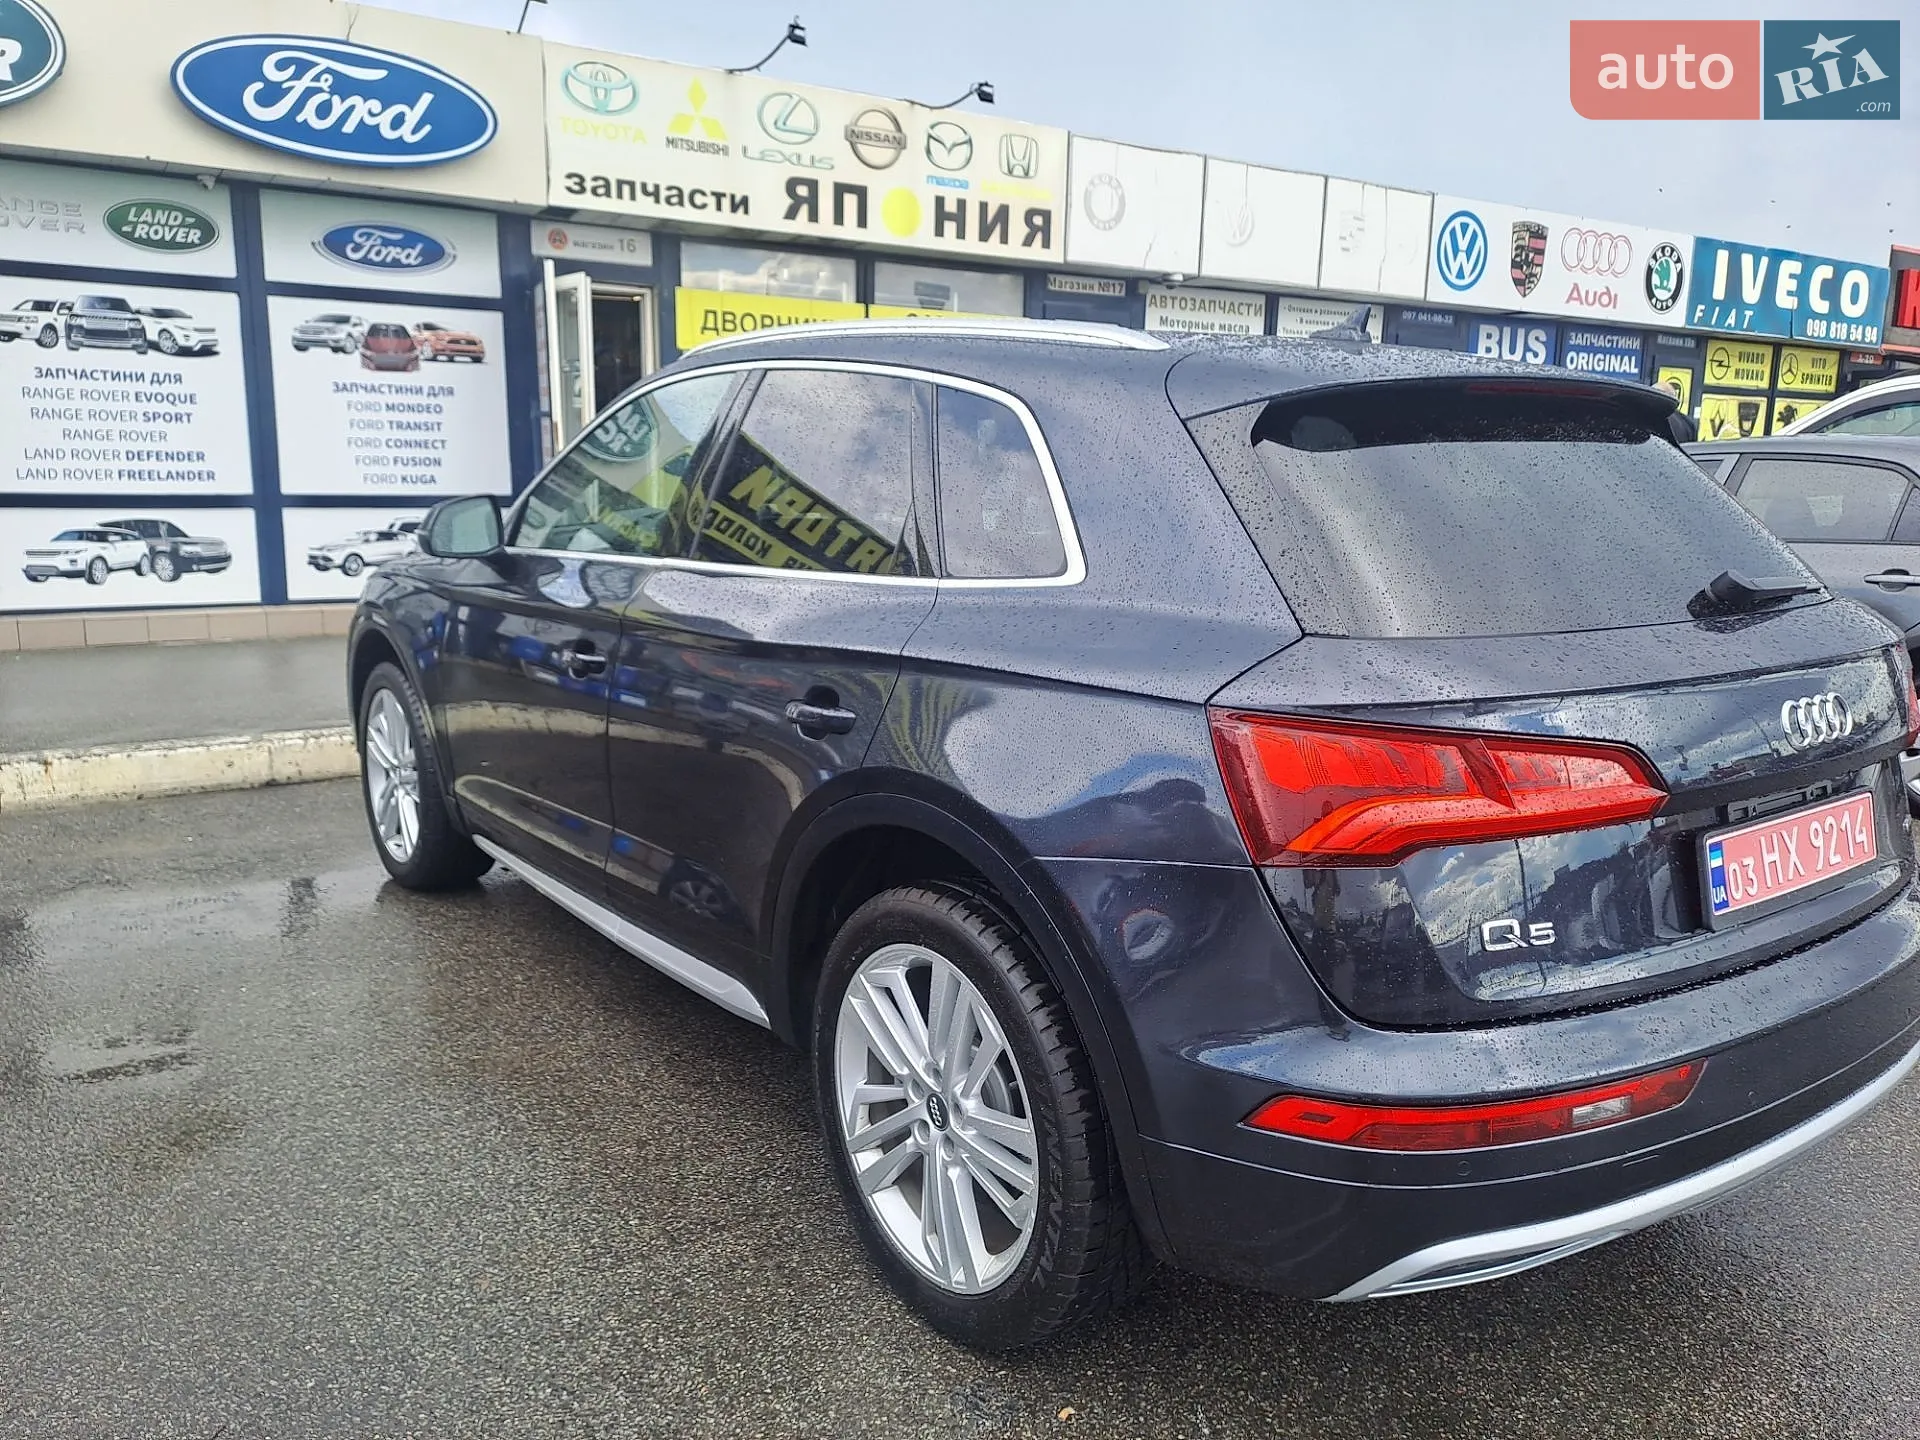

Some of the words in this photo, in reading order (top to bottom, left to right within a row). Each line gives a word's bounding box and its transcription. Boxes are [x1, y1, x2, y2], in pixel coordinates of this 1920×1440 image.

[243, 50, 434, 144] Ford
[560, 116, 647, 144] TOYOTA
[850, 128, 901, 146] NISSAN
[665, 136, 729, 156] MITSUBISHI
[742, 145, 834, 169] LEXUS
[564, 171, 750, 215] запчасти
[134, 225, 201, 244] ROVER
[346, 228, 424, 265] Ford
[618, 238, 637, 253] 16
[1048, 276, 1095, 291] Магазин
[1099, 280, 1124, 296] №17
[1712, 249, 1869, 318] IVECO
[1149, 294, 1264, 317] АВТОЗАПЧАСТИ
[1565, 283, 1618, 309] Audi
[1159, 315, 1216, 332] Моторные
[1218, 323, 1250, 334] масла
[1693, 304, 1754, 328] FIAT
[1569, 331, 1640, 349] ЗАПЧАСТИНИ
[1806, 318, 1827, 338] 098
[1829, 321, 1847, 340] 818
[1849, 324, 1862, 341] 54
[1864, 326, 1877, 343] 94
[1477, 324, 1547, 364] BUS
[1566, 351, 1638, 373] ORIGINAL
[1737, 351, 1765, 364] VIVARO
[1811, 357, 1826, 369] VITO
[34, 366, 146, 383] ЗАПЧАСТИНИ
[150, 371, 183, 386] ДЛЯ
[1734, 367, 1765, 382] MOVANO
[1800, 373, 1833, 387] SPRINTER
[22, 386, 75, 401] RANGE
[80, 388, 131, 402] ROVER
[135, 391, 197, 406] EVOQUE
[332, 381, 424, 396] ЗАПЧАСТИНИ
[427, 385, 455, 398] ДЛЯ
[30, 406, 83, 422] RANGE
[88, 408, 138, 423] ROVER
[142, 411, 193, 424] SPORT
[347, 400, 382, 412] FORD
[385, 402, 443, 414] MONDEO
[62, 427, 113, 441] RANGE
[119, 429, 168, 443] ROVER
[349, 419, 385, 430] FORD
[387, 420, 443, 432] TRANSIT
[347, 437, 382, 449] FORD
[385, 438, 448, 450] CONNECT
[24, 447, 66, 461] LAND
[71, 448, 121, 461] ROVER
[125, 449, 206, 462] DEFENDER
[355, 455, 390, 466] FORD
[392, 456, 442, 467] FUSION
[16, 467, 58, 481] LAND
[63, 468, 113, 481] ROVER
[118, 468, 216, 482] FREELANDER
[362, 473, 397, 484] FORD
[400, 474, 437, 485] KUGA
[1713, 886, 1727, 904] UA
[1728, 856, 1758, 901] 03
[1760, 826, 1805, 888] HX
[1809, 805, 1869, 872] 9214
[1481, 919, 1556, 952] Q5
